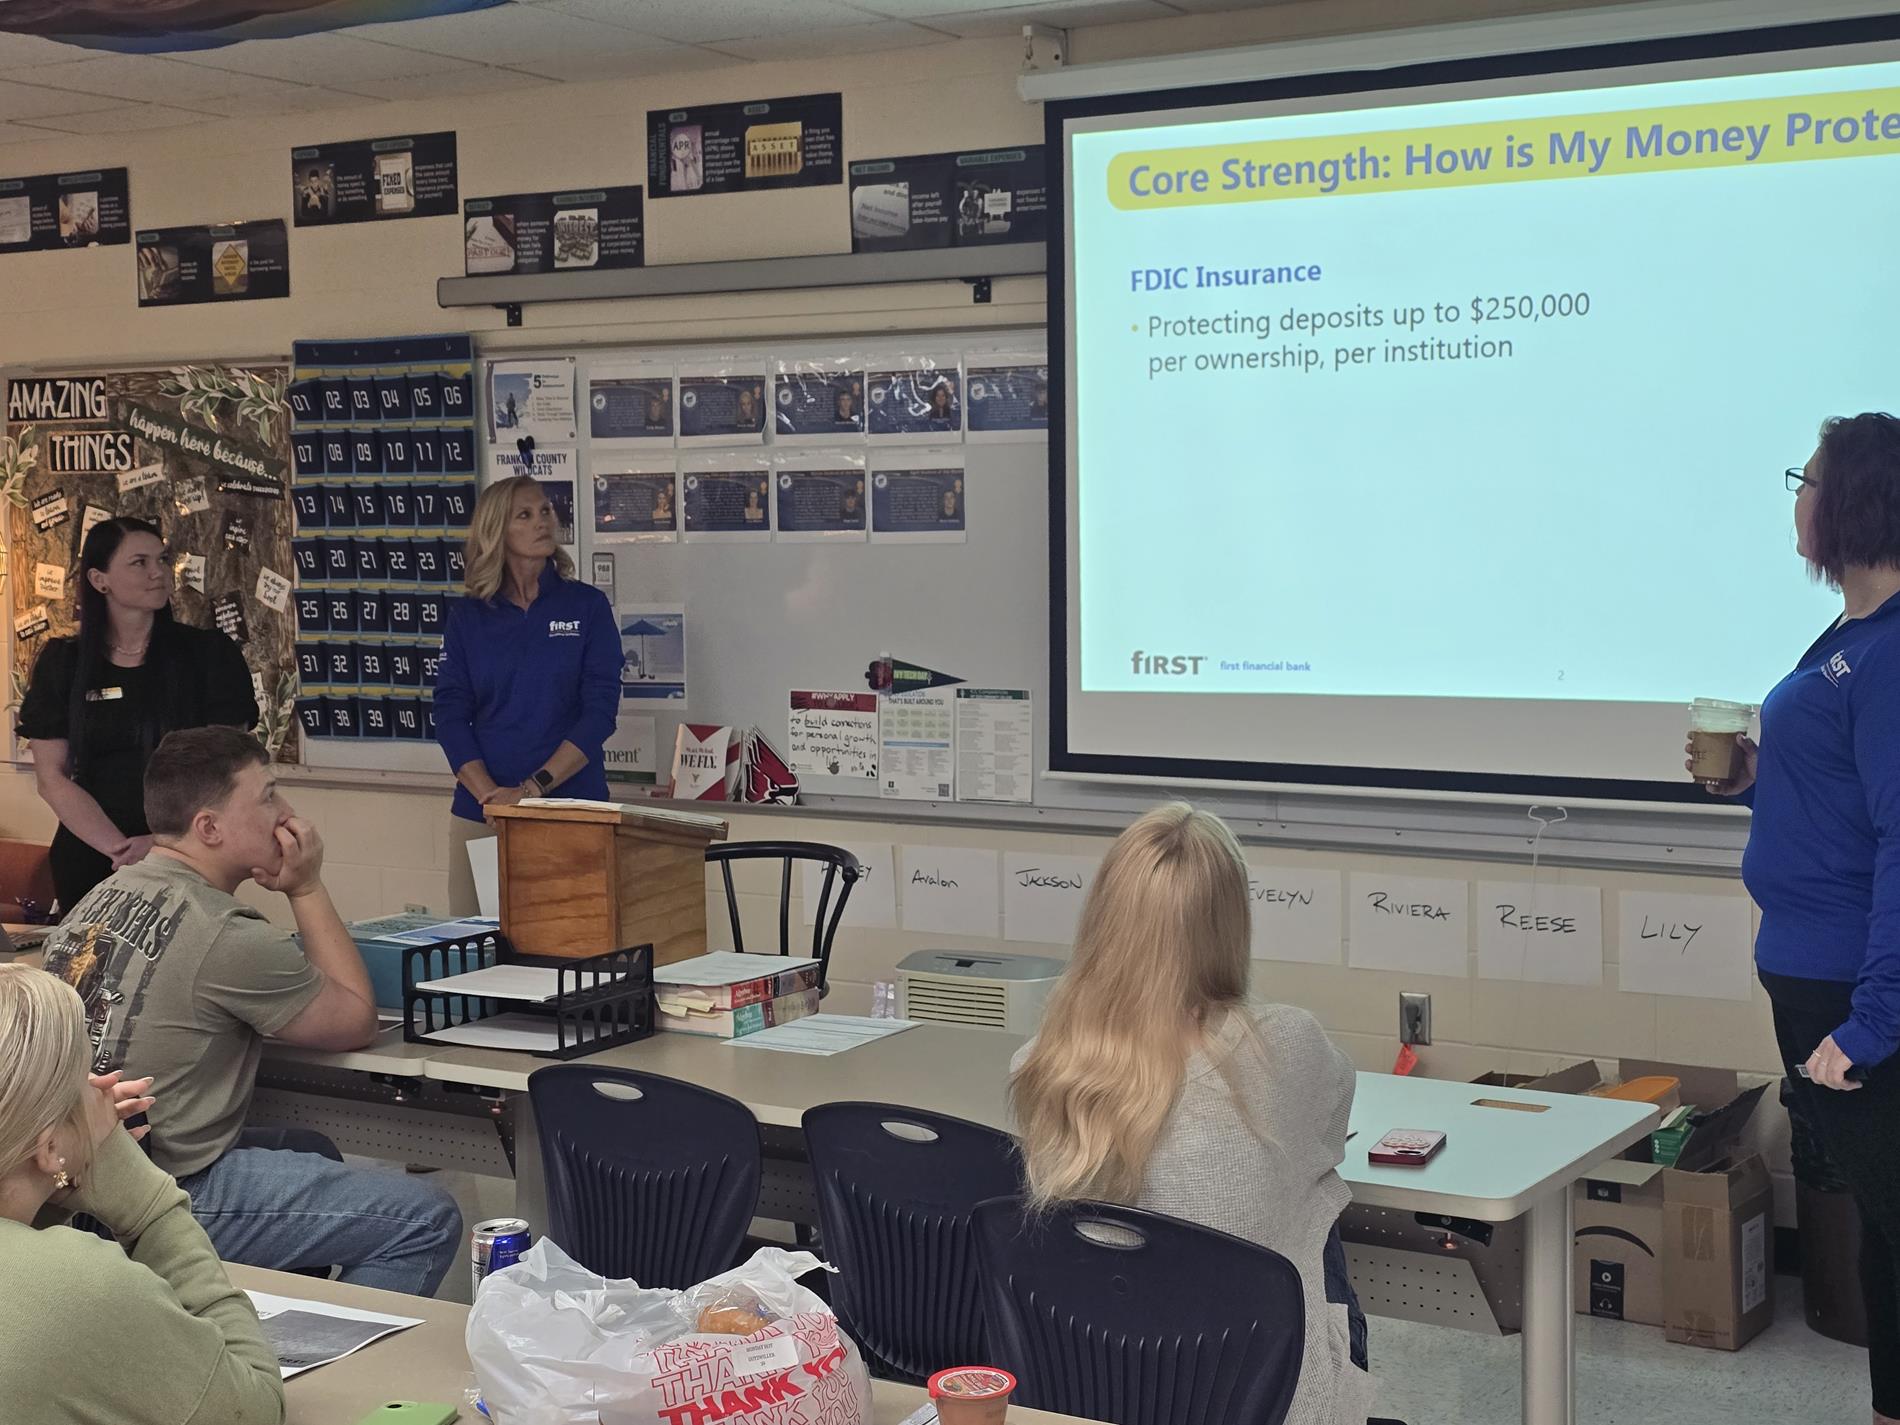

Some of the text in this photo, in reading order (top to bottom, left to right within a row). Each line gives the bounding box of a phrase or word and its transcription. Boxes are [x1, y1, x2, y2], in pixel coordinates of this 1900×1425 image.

[673, 141, 690, 152] APR
[752, 142, 794, 152] ASSET
[1128, 164, 1210, 197] Core
[1221, 146, 1391, 193] Strength:
[1405, 143, 1492, 176] How
[1505, 135, 1534, 168] is
[1548, 130, 1611, 173] My
[1625, 124, 1770, 161] Money
[1130, 264, 1322, 292] FDIC Insurance
[1149, 292, 1590, 339] Protecting deposits up to $250,000
[1149, 335, 1513, 380] per ownership, per institution
[533, 374, 542, 389] 5
[9, 379, 106, 419] AMAZING
[293, 386, 462, 411] 01 02 03 04 05 06
[129, 407, 178, 444] happen
[180, 427, 210, 457] here
[51, 433, 131, 471] THINGS
[298, 442, 462, 462] 07 08 09 10 11 12
[496, 453, 567, 465] FRANK COUNTY
[513, 465, 553, 476] WILDCATS
[298, 495, 465, 514] 13 14 15 16 17 18
[298, 550, 465, 570] 19 20 21 22 23 24
[302, 601, 438, 622] 25 26 27 28 29
[302, 655, 439, 676] 31 32 33 34 35
[1220, 661, 1240, 671] first
[1242, 660, 1283, 671] financial
[1286, 661, 1311, 672] bank
[1557, 669, 1565, 680] 2
[304, 710, 415, 728] 37 38 39 40
[805, 713, 828, 728] build
[790, 726, 877, 748] for personal growth
[792, 743, 806, 752] and
[911, 869, 958, 889] Avalon
[1367, 891, 1450, 921] RIVIERA
[1496, 904, 1577, 934] REESE
[1640, 915, 1702, 954] LILY
[658, 1370, 805, 1425] THANK
